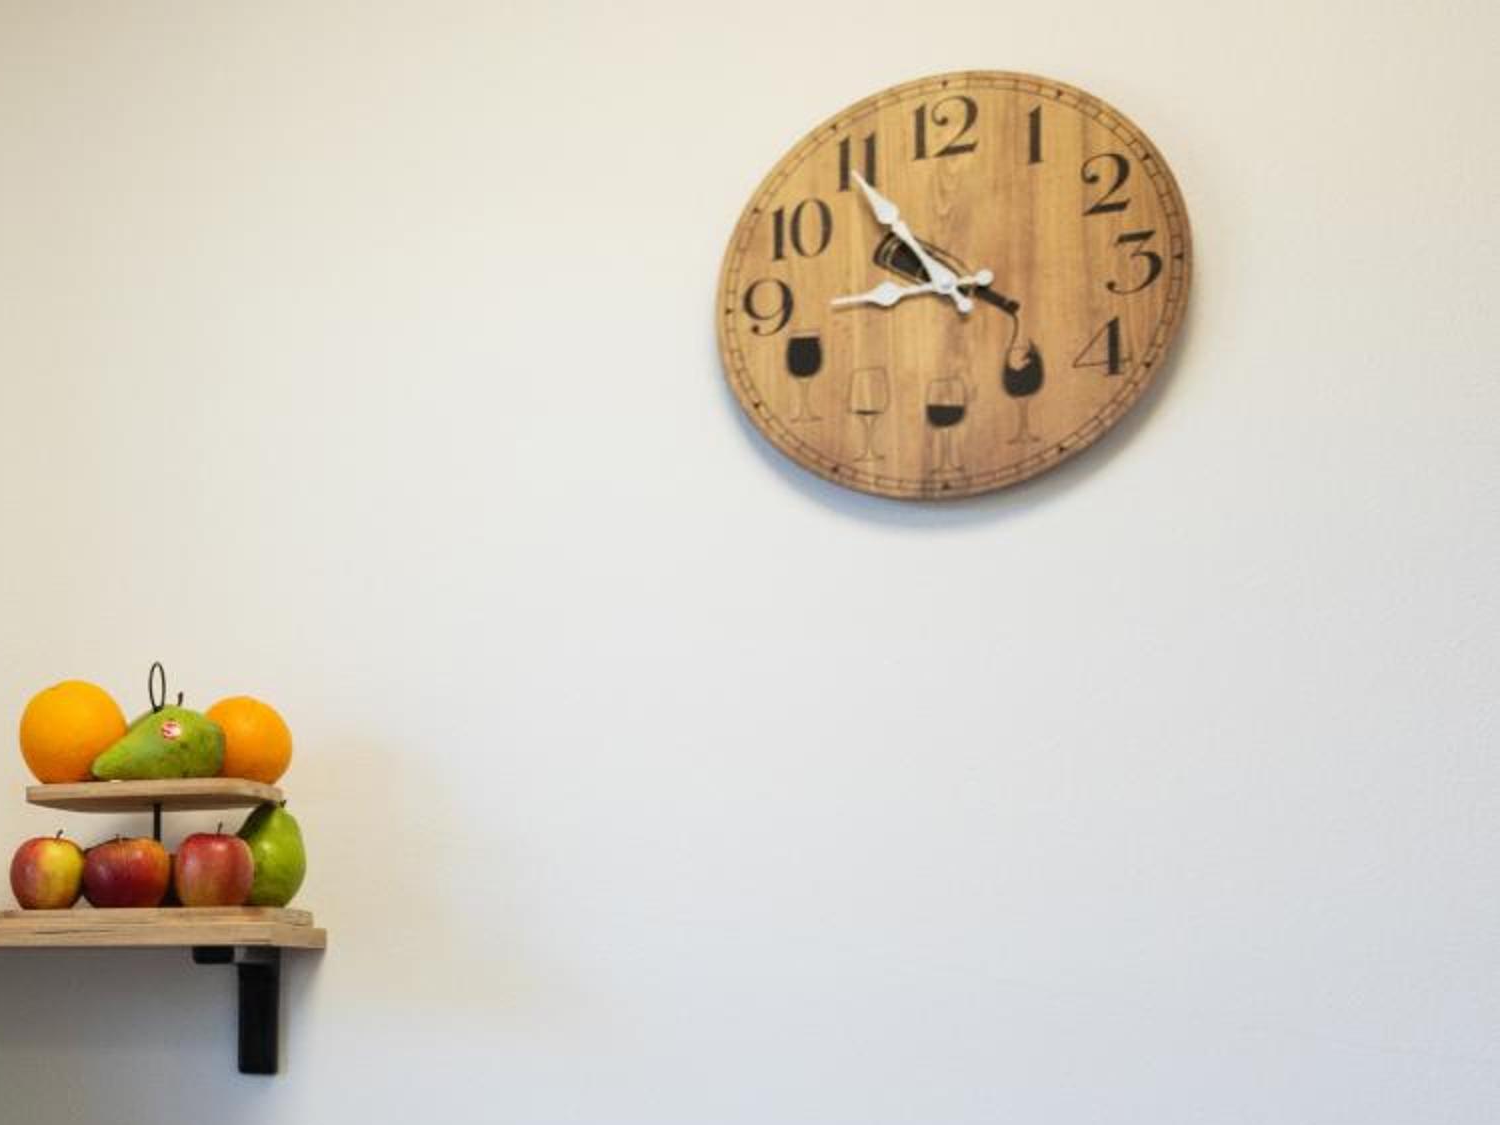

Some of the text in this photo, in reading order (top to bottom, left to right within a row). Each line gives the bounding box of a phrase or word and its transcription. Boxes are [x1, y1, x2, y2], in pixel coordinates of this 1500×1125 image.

[913, 95, 978, 160] 12
[1028, 105, 1044, 164] 1
[838, 132, 876, 192] 11
[1081, 153, 1131, 217] 2
[772, 199, 833, 262] 10
[1106, 229, 1163, 295] 3
[743, 278, 794, 337] 9
[1073, 316, 1132, 377] 4
